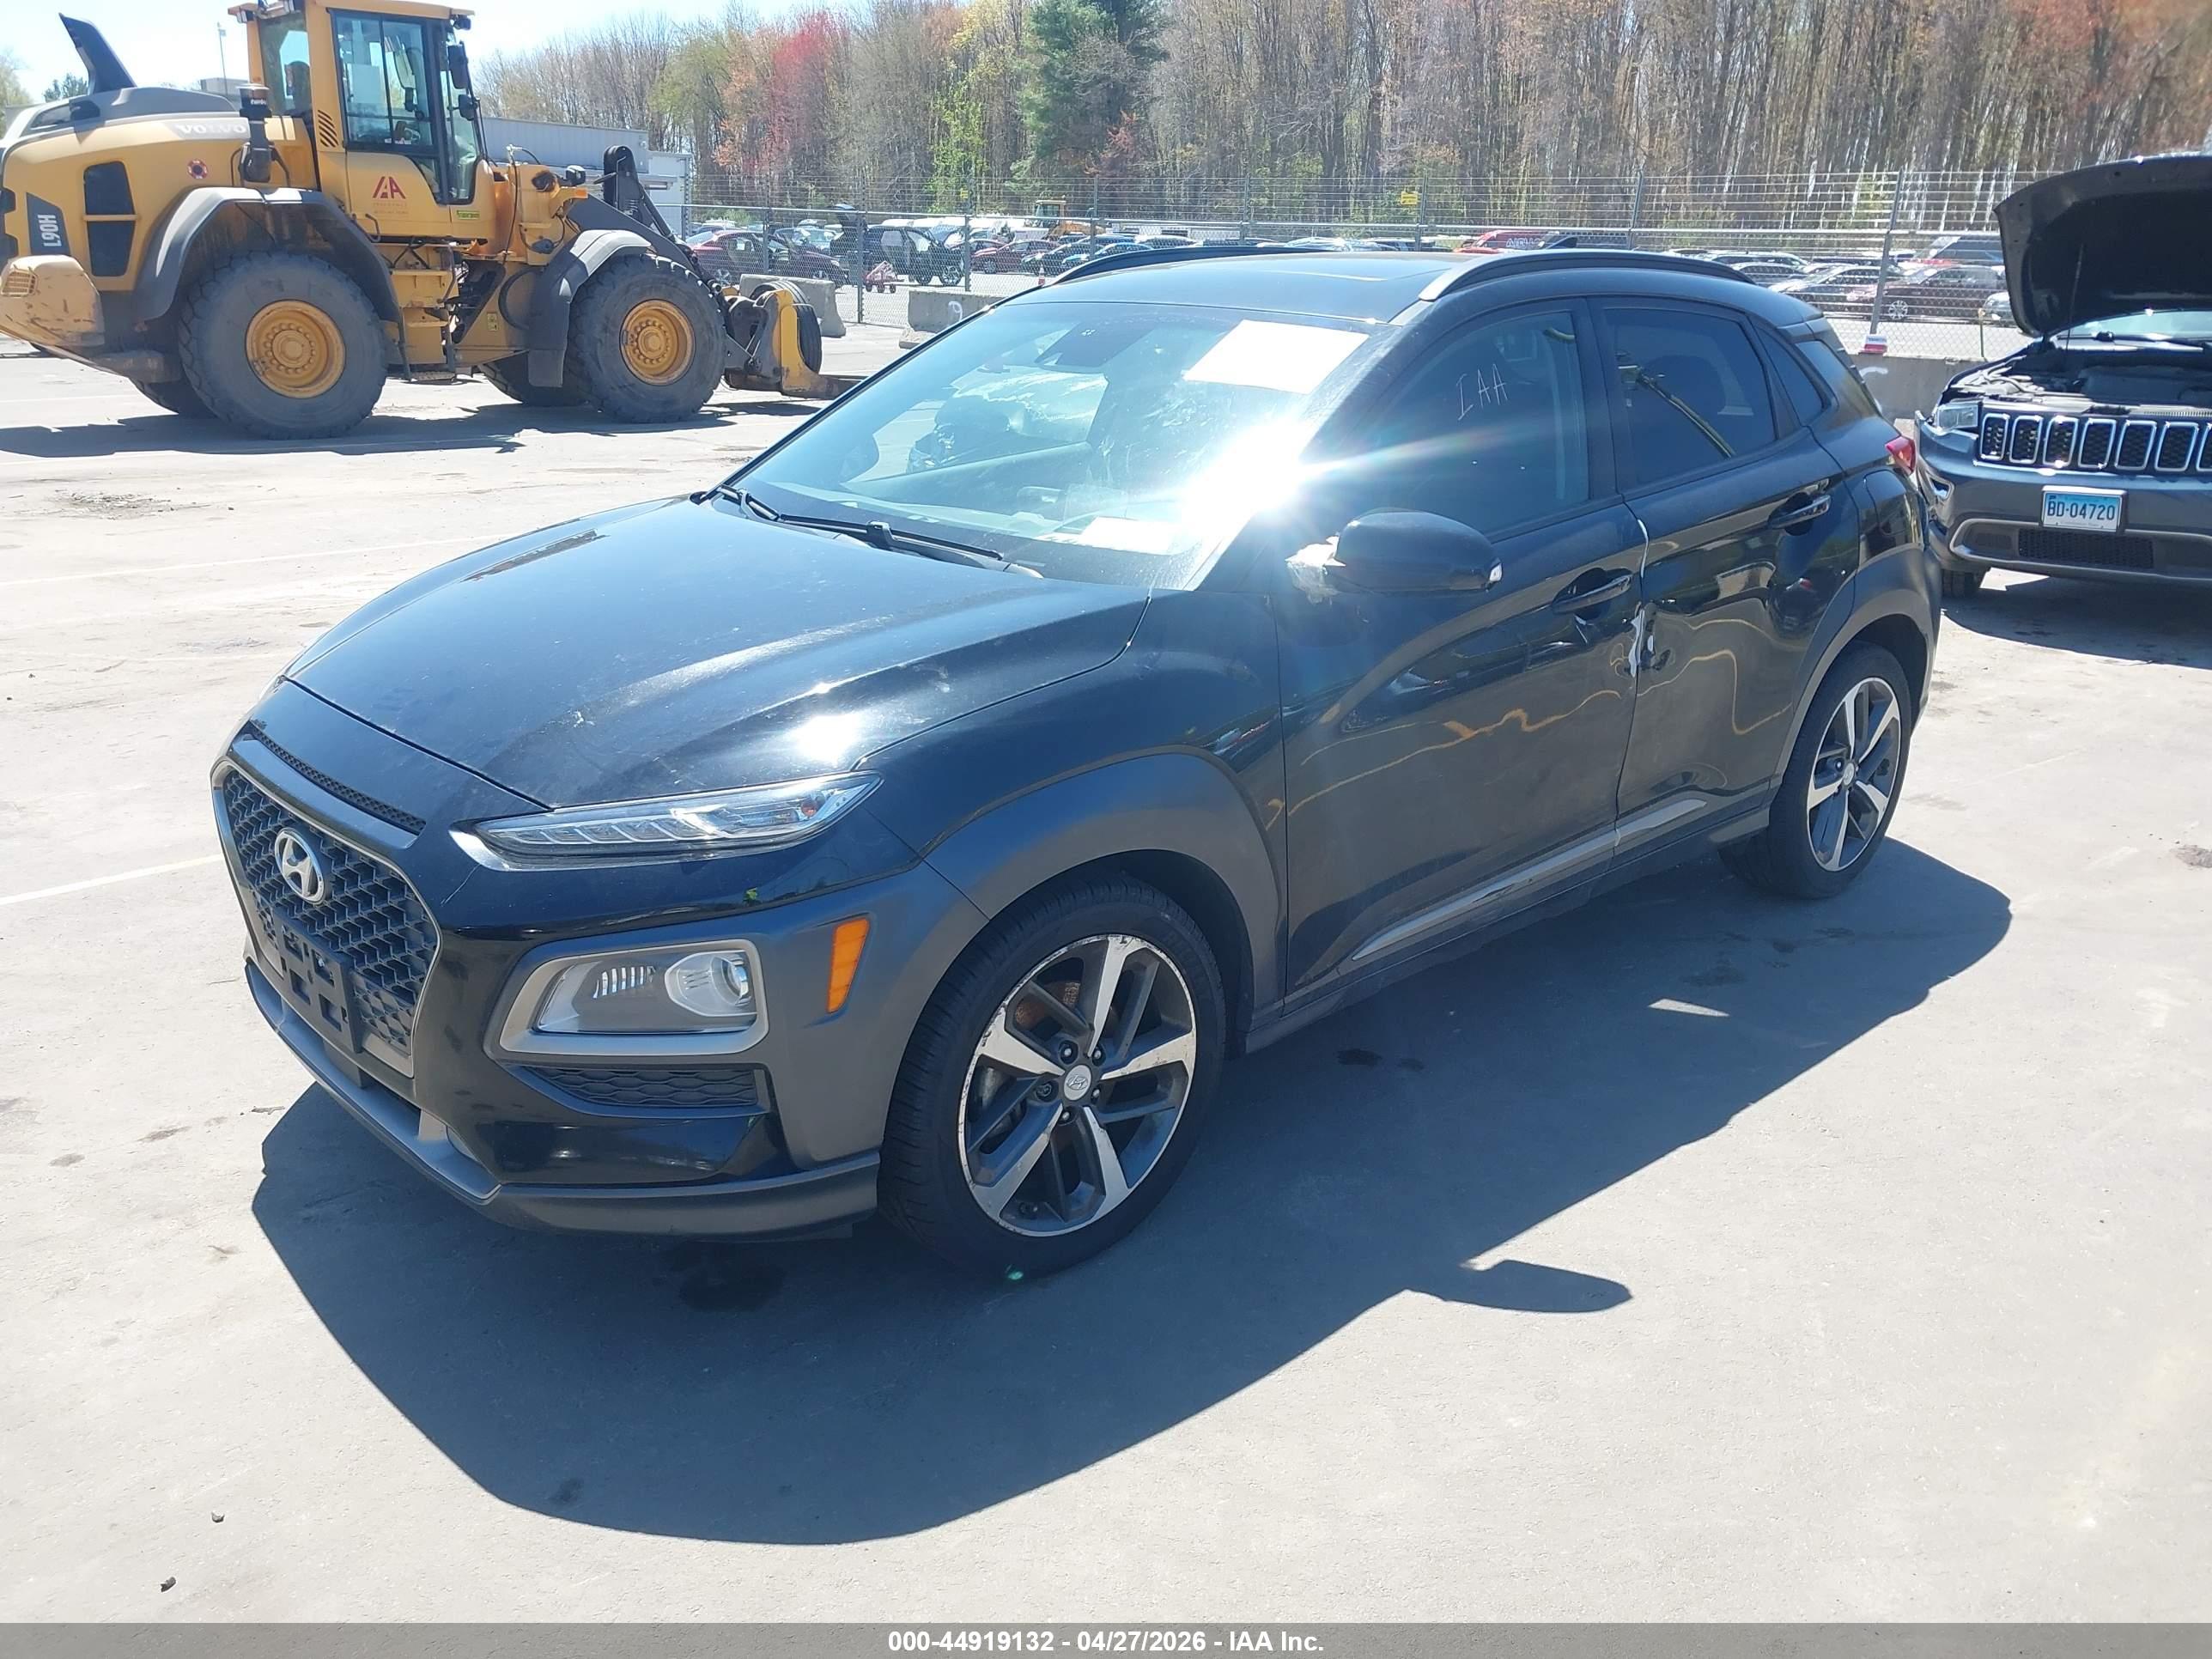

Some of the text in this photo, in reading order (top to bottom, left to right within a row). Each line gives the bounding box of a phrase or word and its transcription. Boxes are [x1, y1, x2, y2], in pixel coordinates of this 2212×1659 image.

[175, 123, 247, 134] VOLVO
[37, 214, 63, 246] L90H
[1455, 363, 1509, 421] IAA
